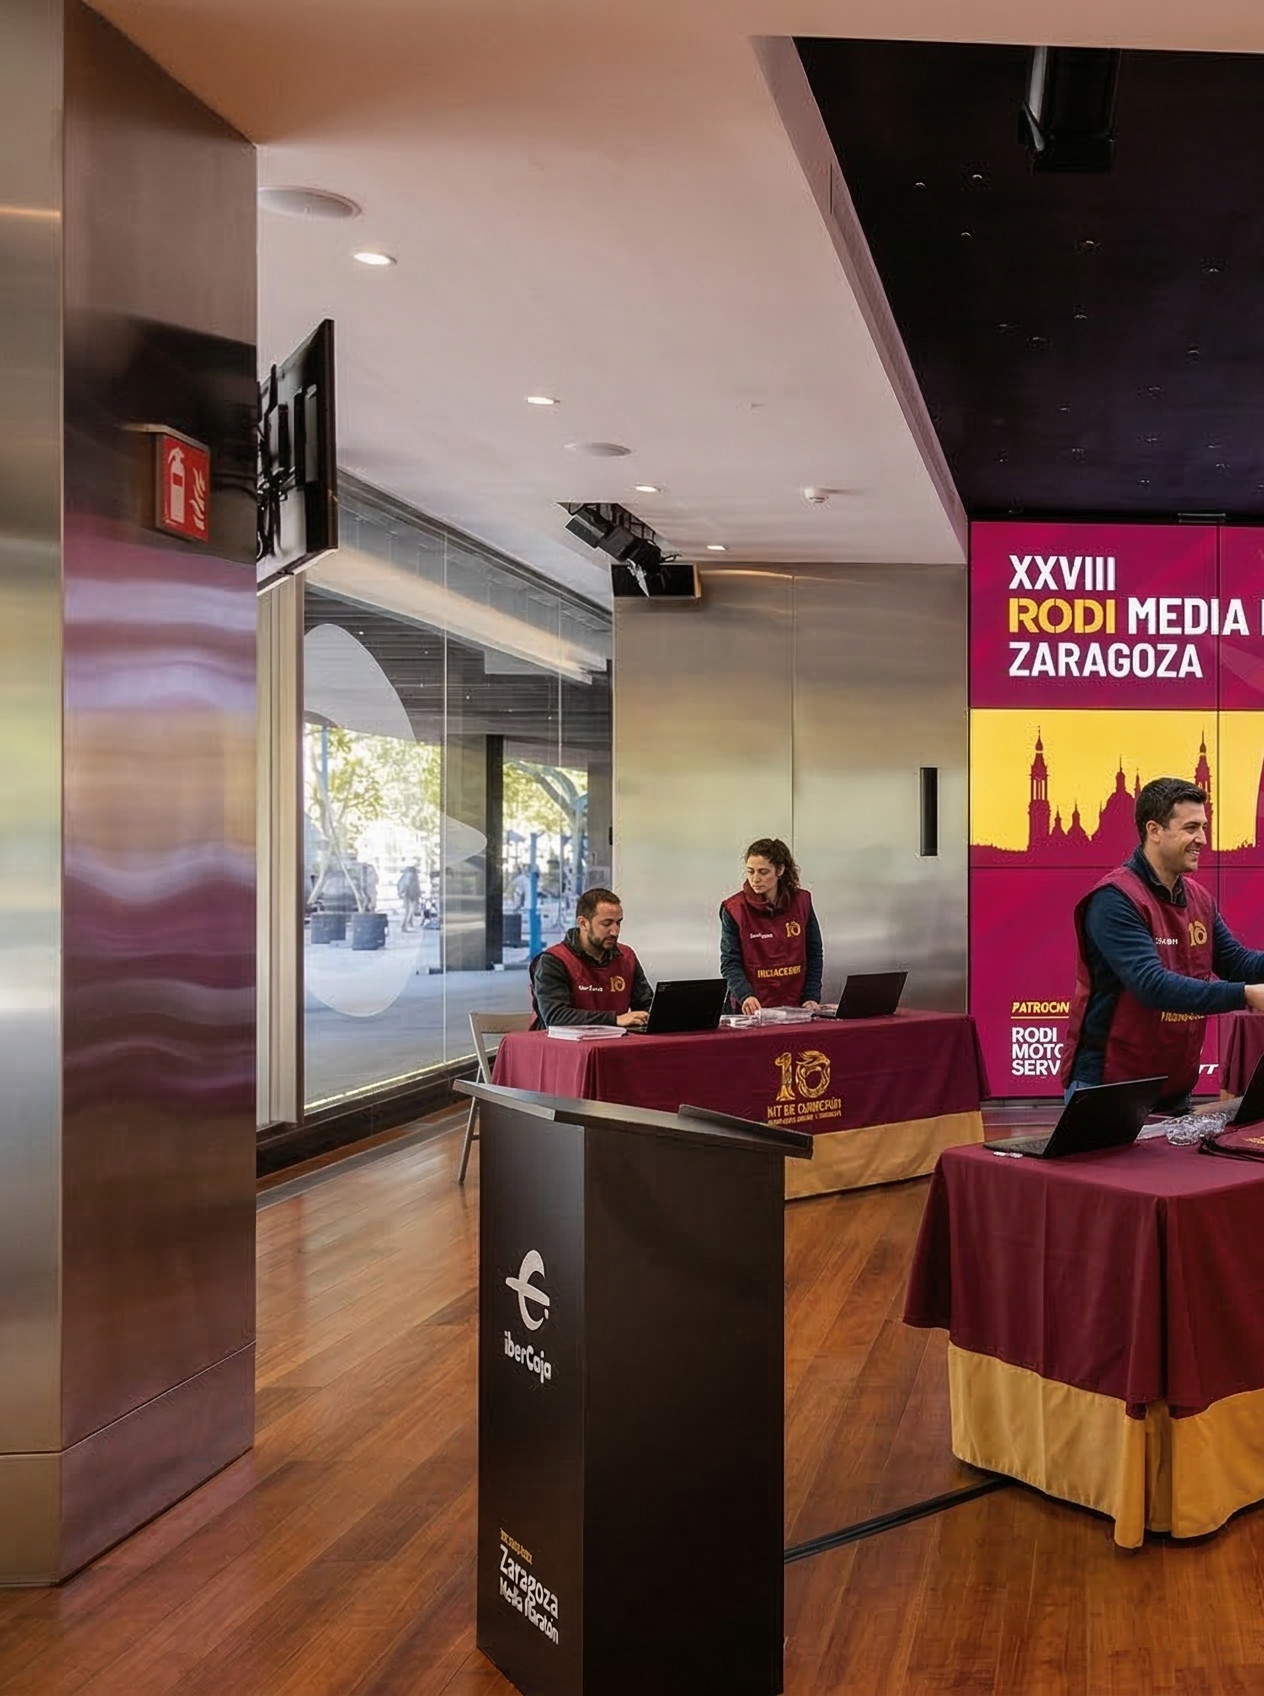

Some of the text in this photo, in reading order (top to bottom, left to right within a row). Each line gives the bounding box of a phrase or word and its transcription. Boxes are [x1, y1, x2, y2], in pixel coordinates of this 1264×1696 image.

[1009, 556, 1116, 591] XXVIII
[1009, 598, 1116, 635] RODI
[1127, 598, 1249, 637] MEDIA
[1009, 642, 1203, 679] ZARAGOZA
[1011, 1027, 1057, 1043] RODI
